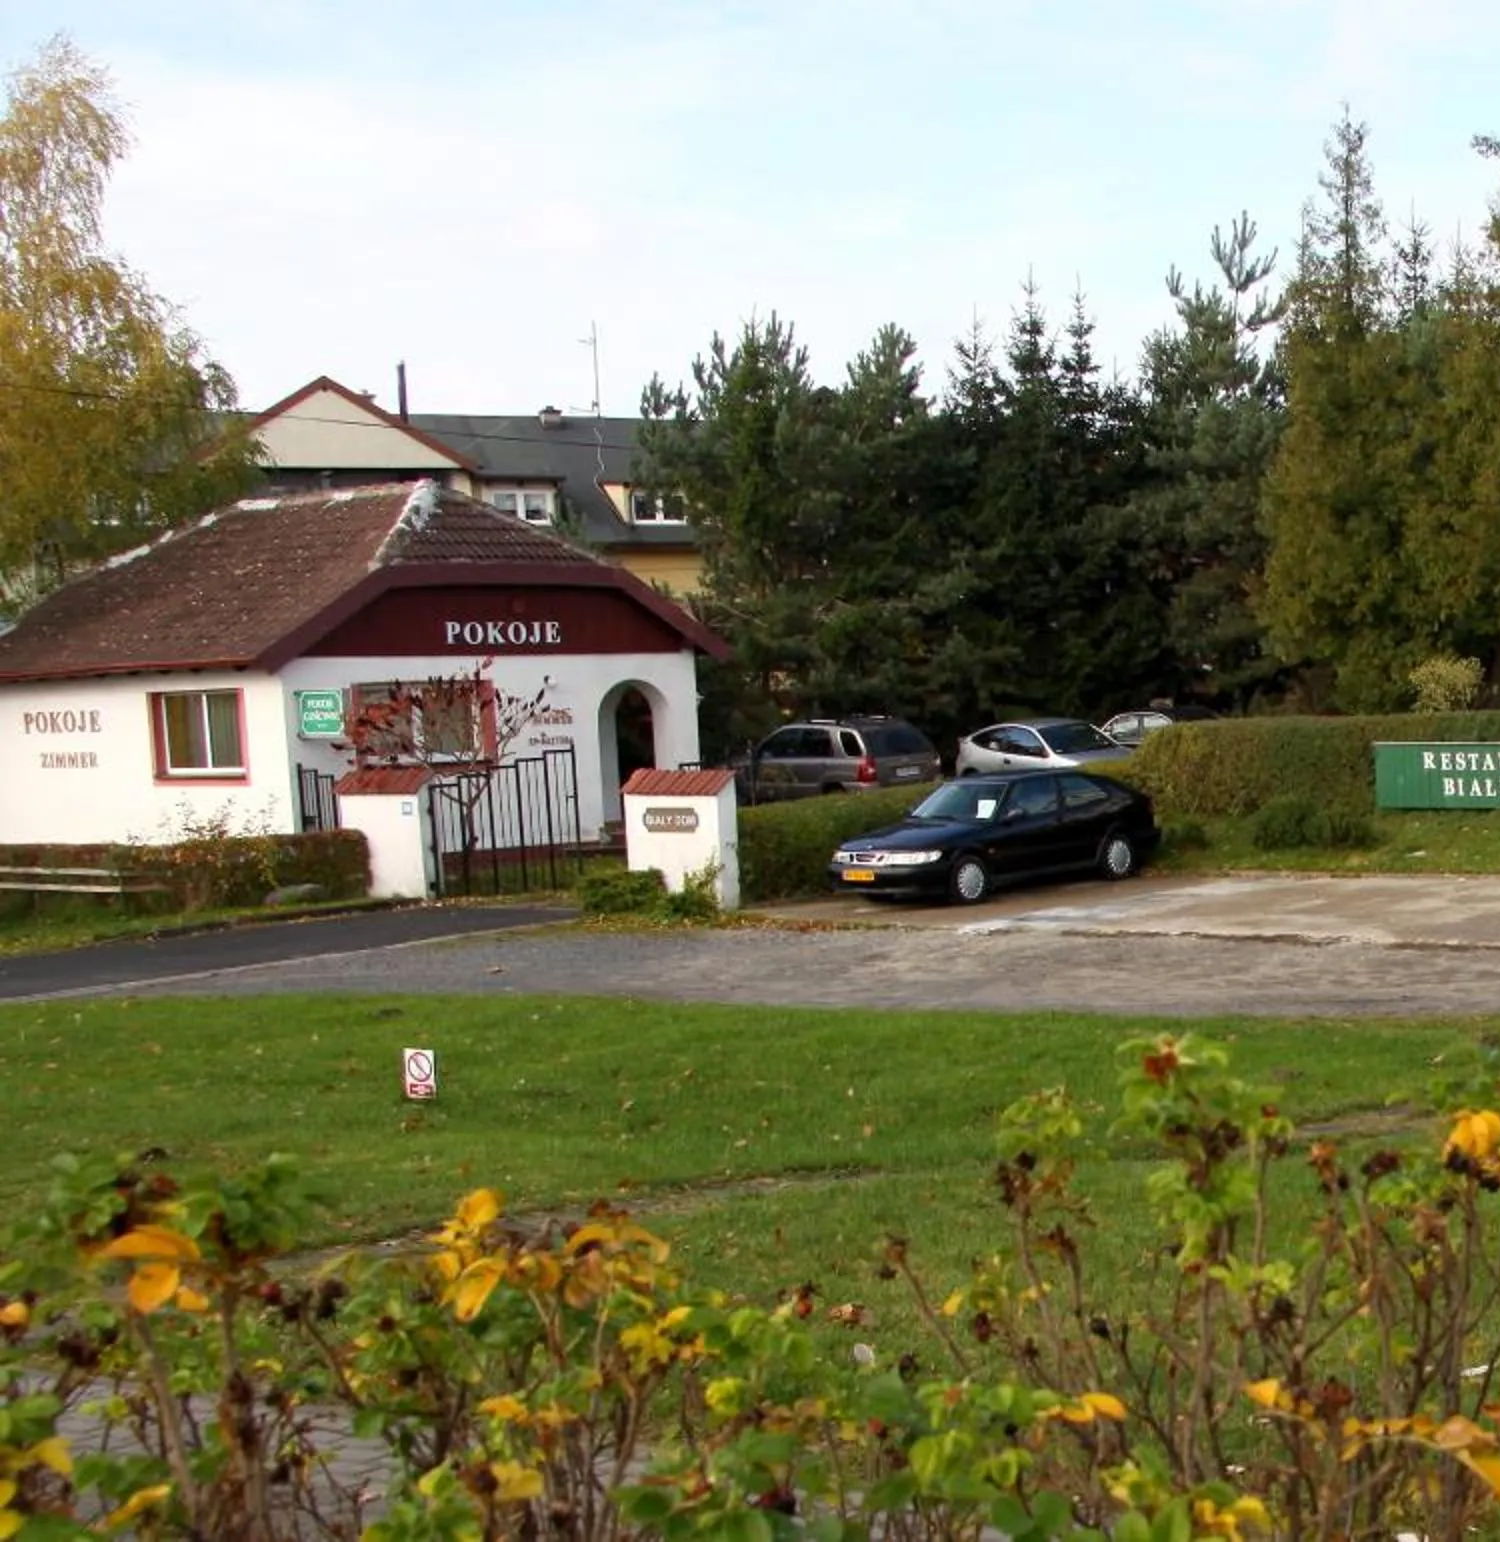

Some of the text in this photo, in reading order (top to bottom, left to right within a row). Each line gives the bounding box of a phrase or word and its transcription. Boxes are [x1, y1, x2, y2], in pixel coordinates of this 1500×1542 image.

[445, 620, 561, 645] POKOJE
[23, 709, 103, 735] POKOJE
[40, 751, 99, 769] ZIMMER
